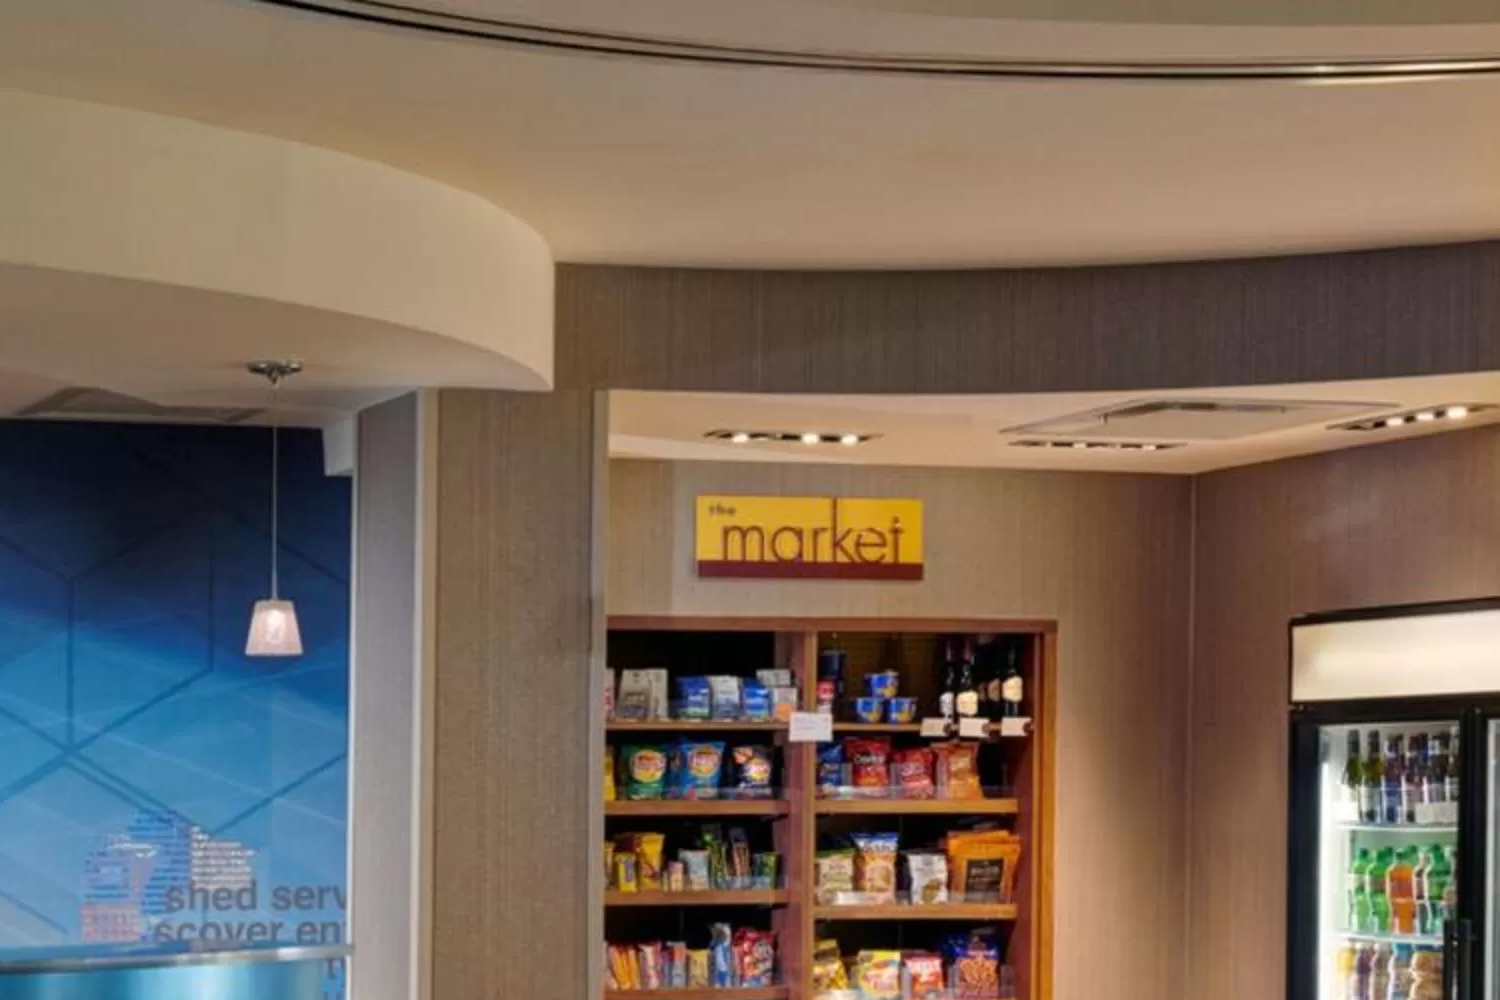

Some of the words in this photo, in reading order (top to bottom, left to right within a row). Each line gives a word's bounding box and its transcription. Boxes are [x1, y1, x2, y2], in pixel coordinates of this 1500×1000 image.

[708, 503, 737, 517] the
[722, 498, 904, 564] market
[297, 920, 349, 945] en
